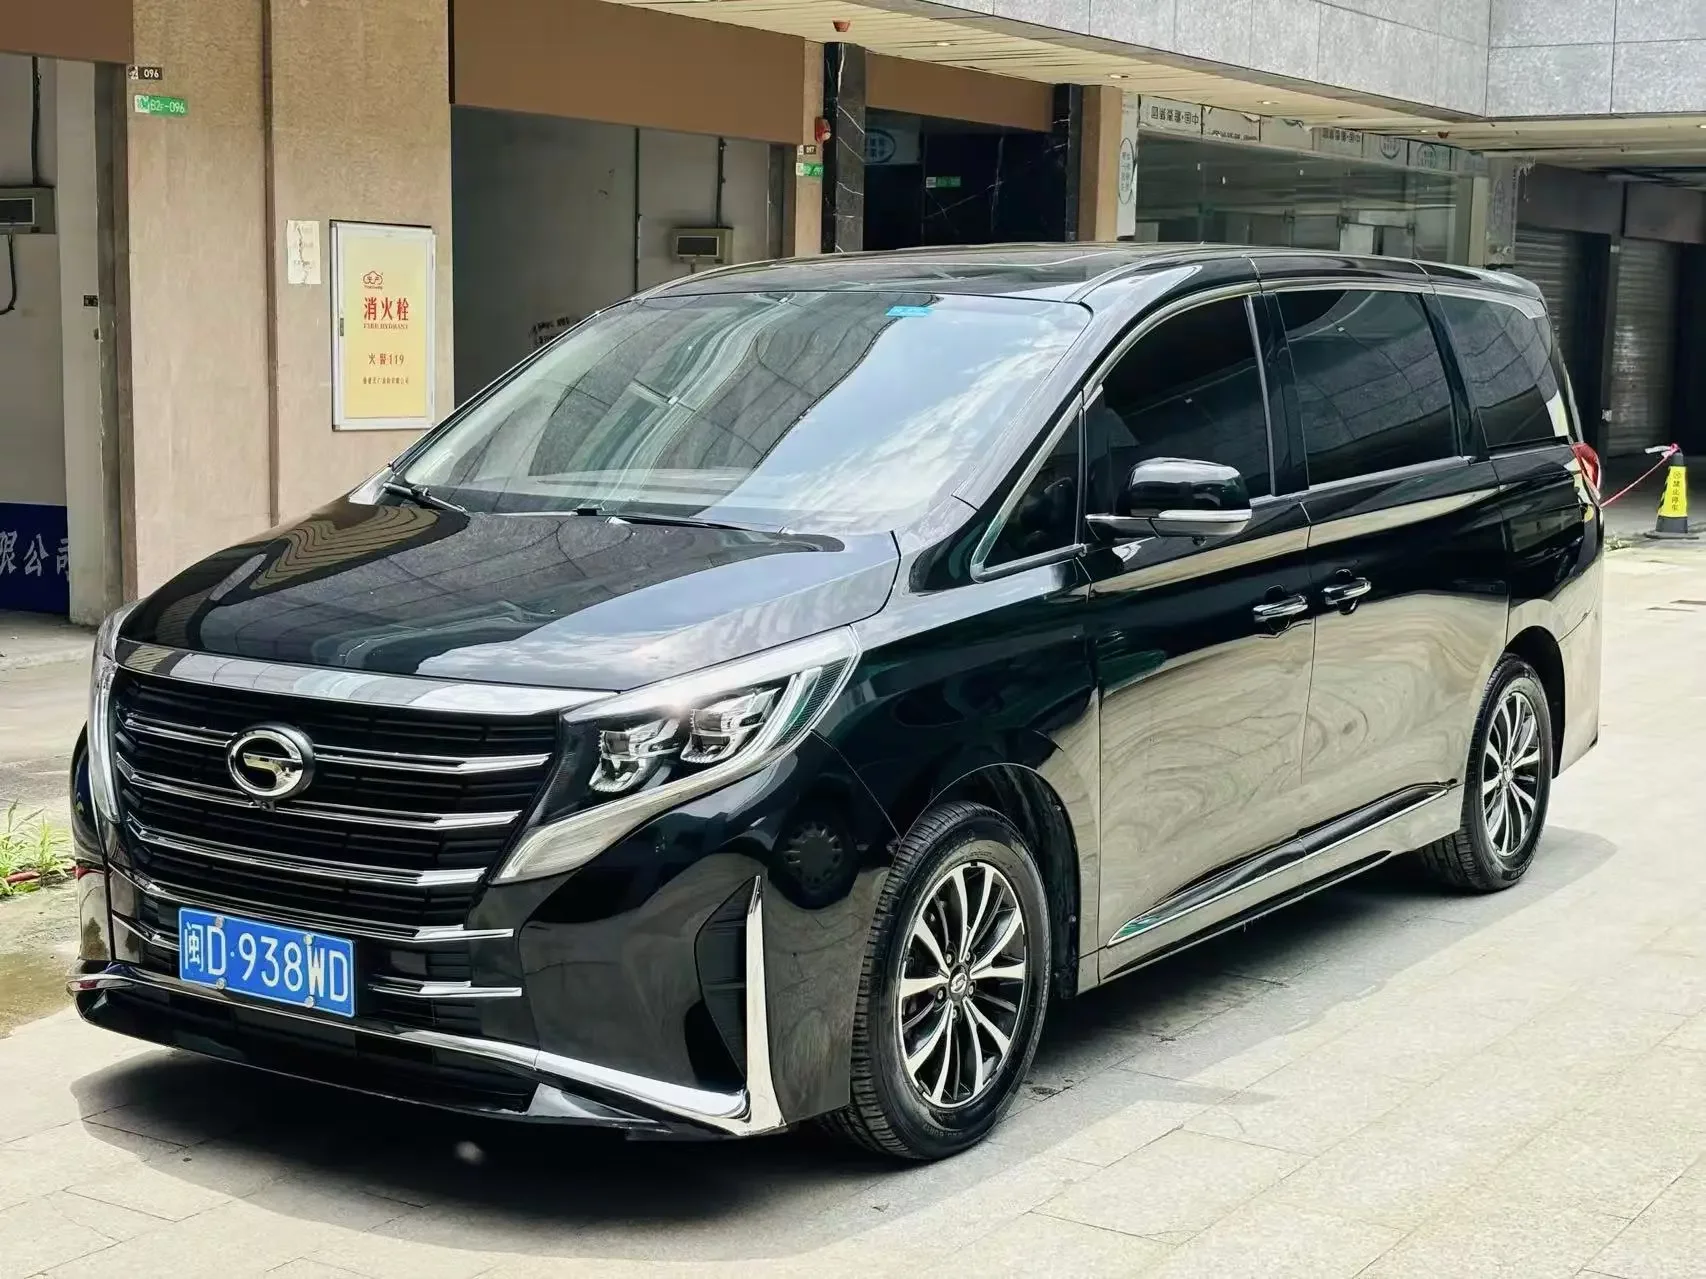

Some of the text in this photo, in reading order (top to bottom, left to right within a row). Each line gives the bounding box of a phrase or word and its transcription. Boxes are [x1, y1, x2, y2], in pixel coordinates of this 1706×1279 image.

[143, 69, 159, 78] 096
[363, 296, 409, 321] 消火栓
